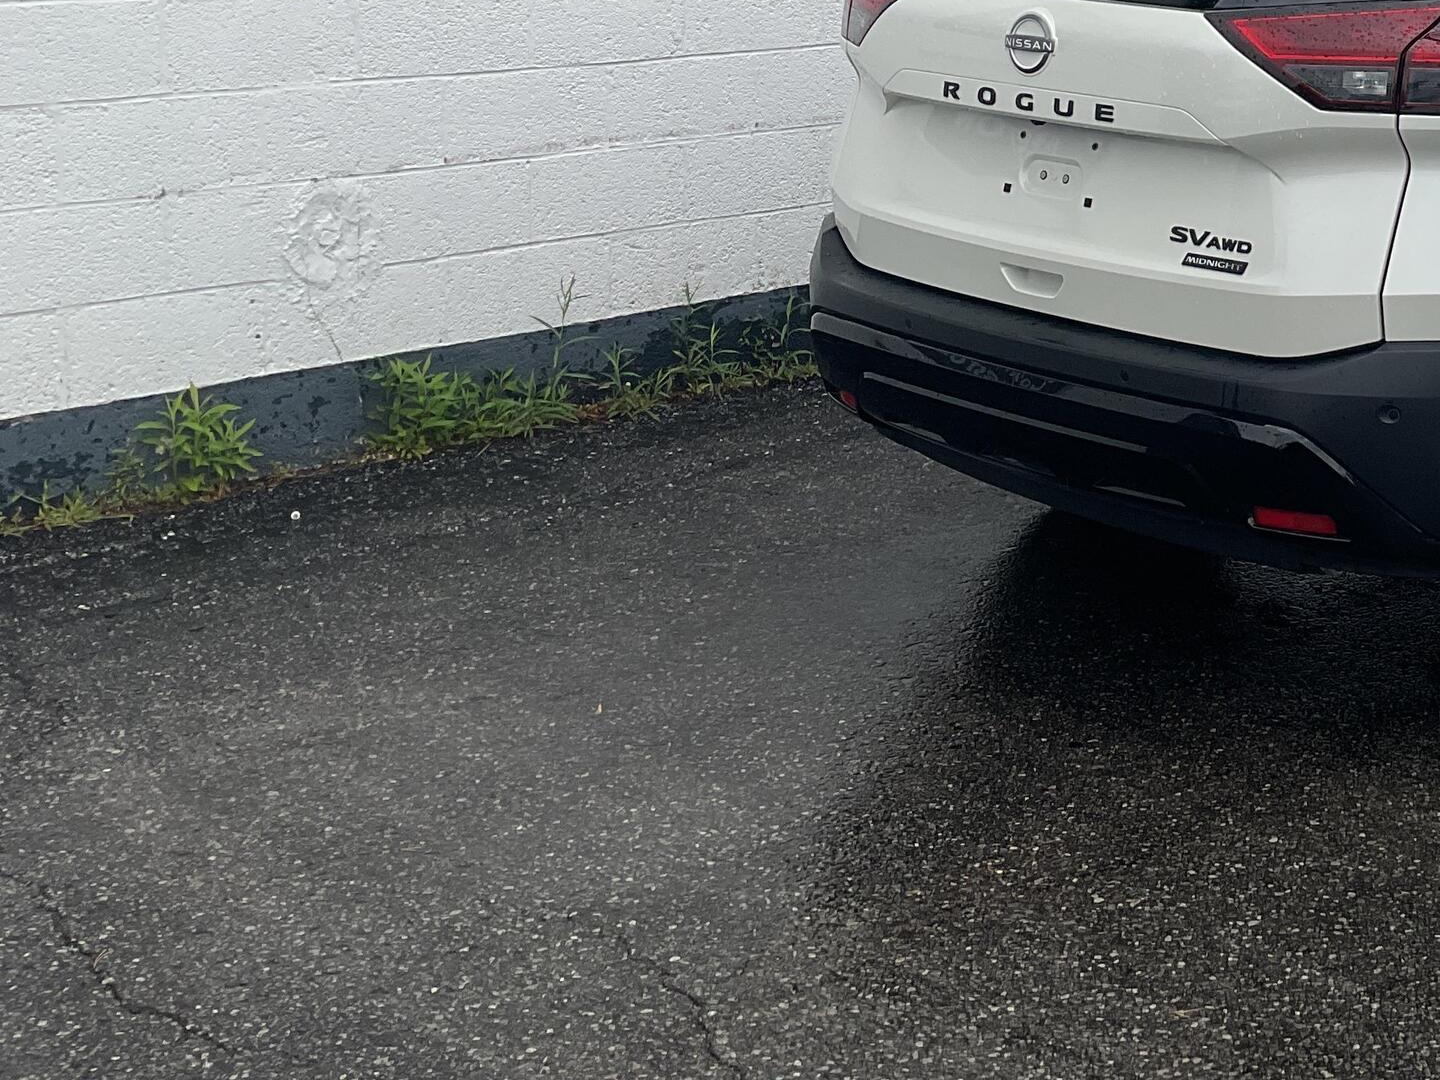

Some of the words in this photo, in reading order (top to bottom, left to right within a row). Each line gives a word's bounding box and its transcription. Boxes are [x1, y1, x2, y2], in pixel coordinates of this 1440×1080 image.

[1005, 37, 1052, 51] NISSAN
[942, 80, 1115, 123] ROGUE
[1185, 255, 1244, 272] MIDNIGHT
